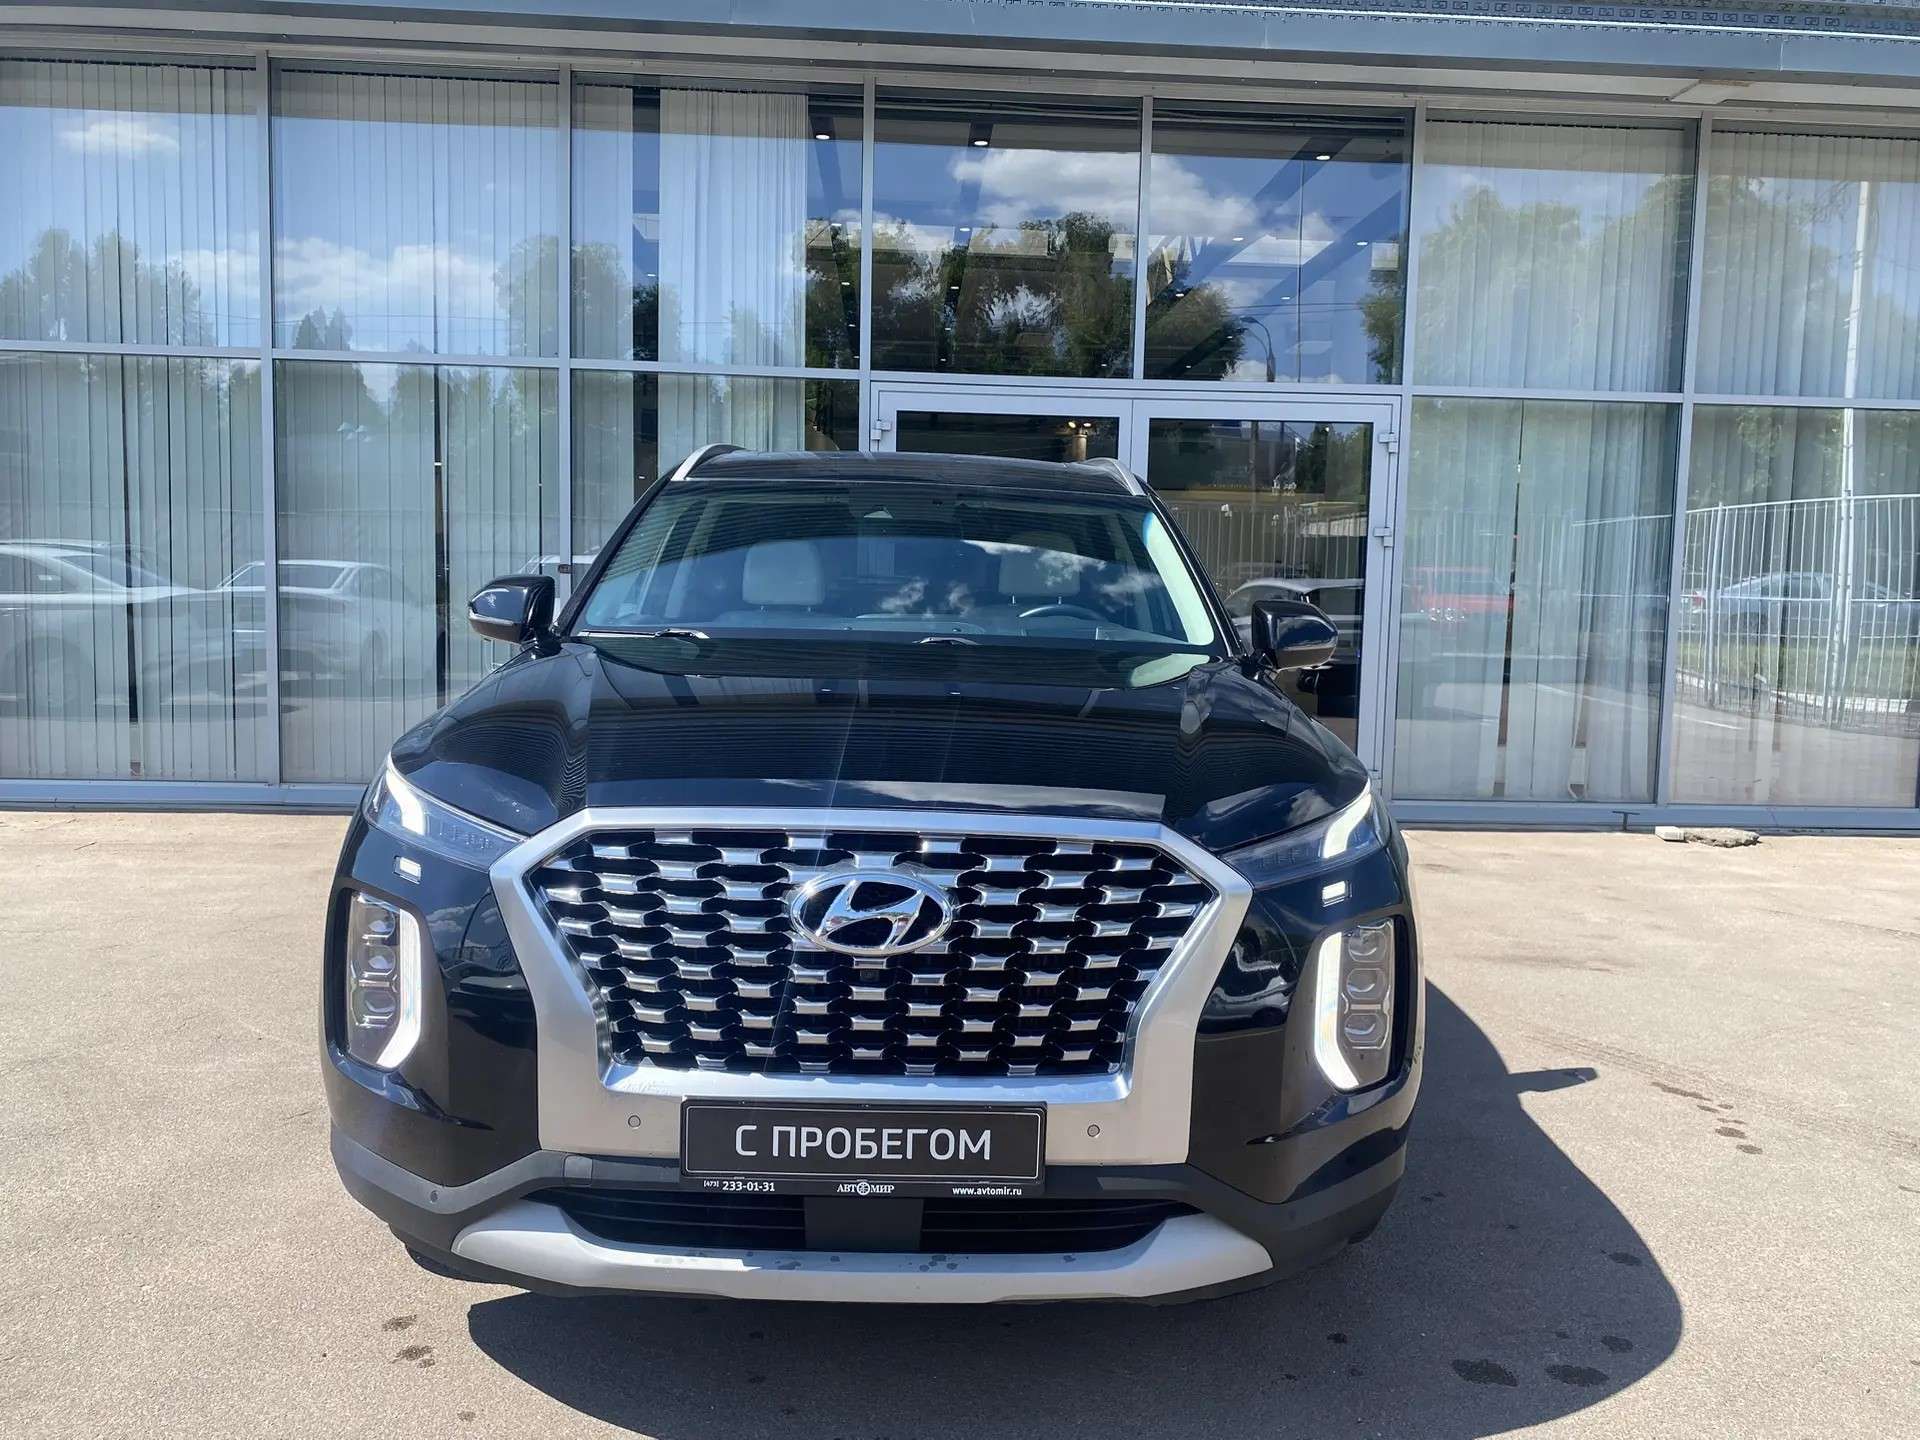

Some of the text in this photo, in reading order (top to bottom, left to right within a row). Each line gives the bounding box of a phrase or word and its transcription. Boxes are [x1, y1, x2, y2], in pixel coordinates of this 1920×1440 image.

[735, 1125, 991, 1160] С ПРОБЕГОМ
[722, 1181, 775, 1192] 233-01-31
[952, 1186, 1022, 1196] www.avtomir.ru
